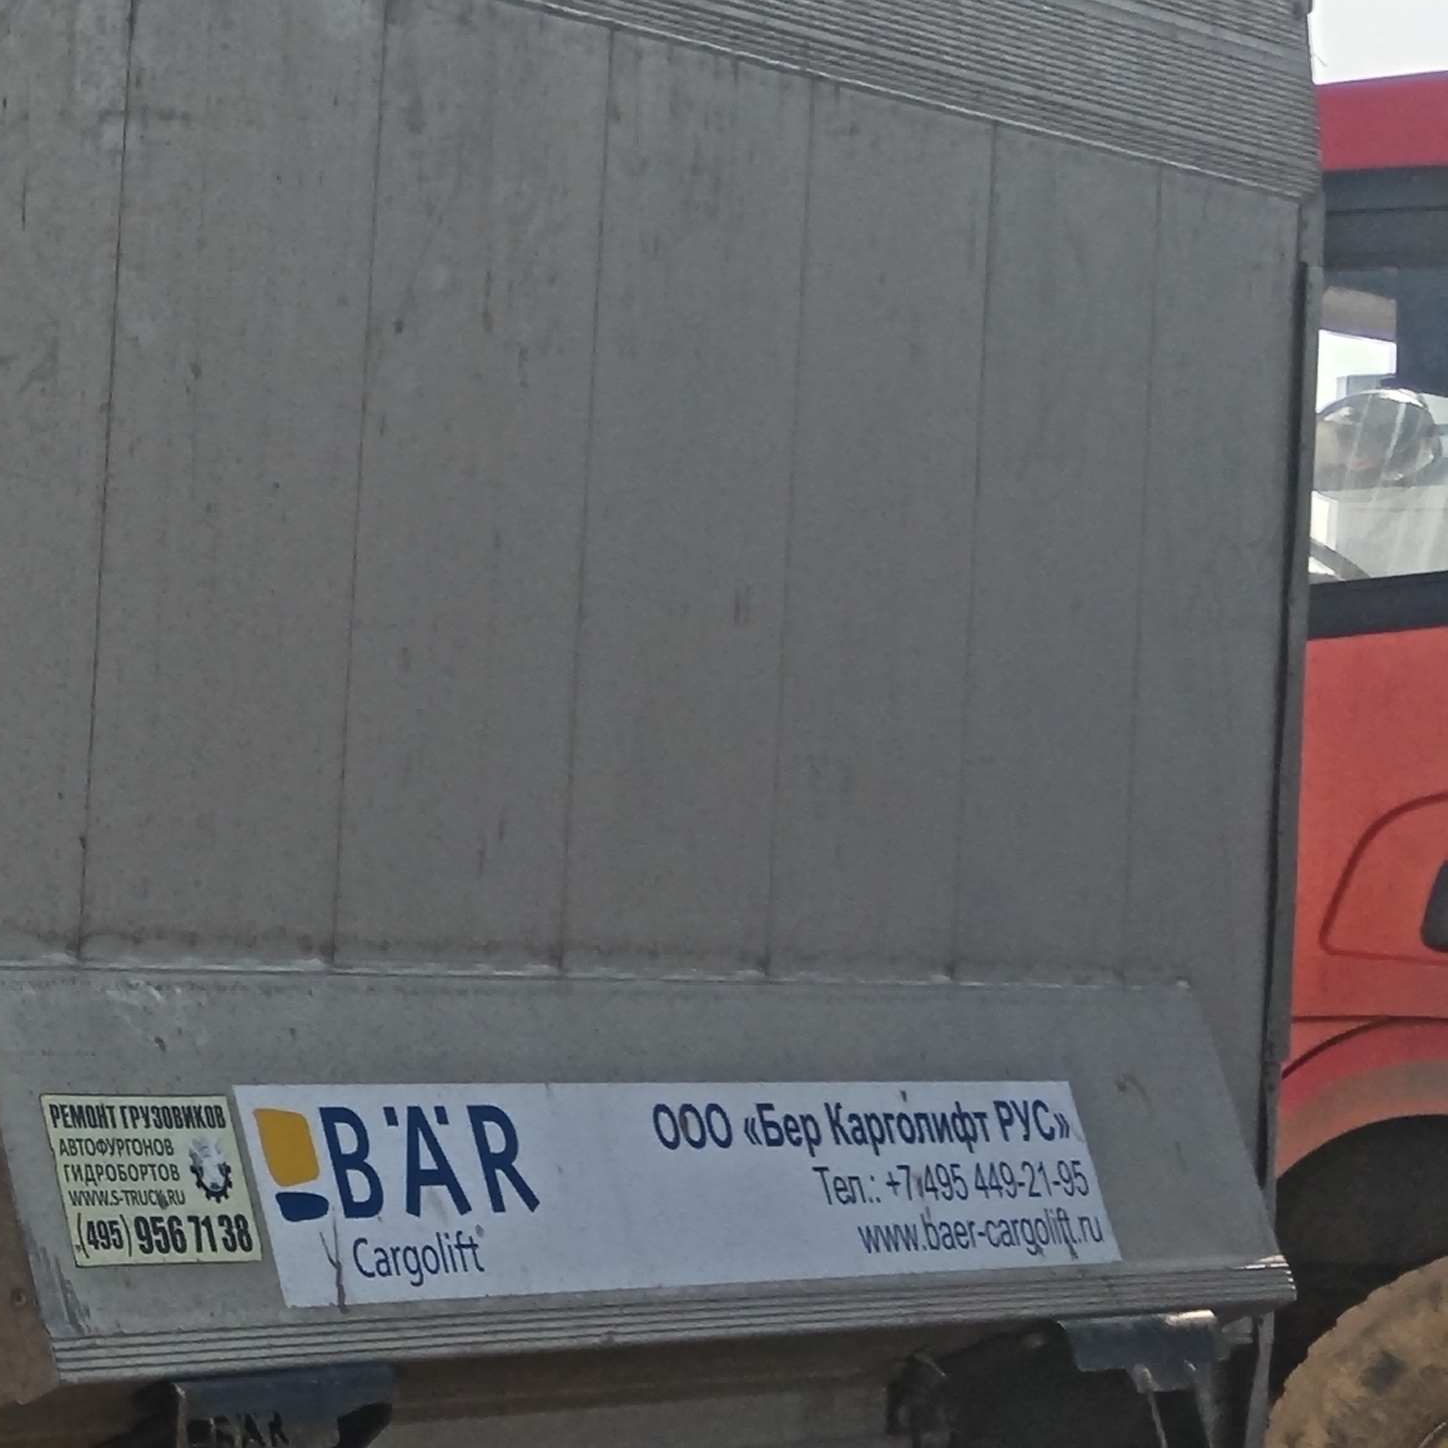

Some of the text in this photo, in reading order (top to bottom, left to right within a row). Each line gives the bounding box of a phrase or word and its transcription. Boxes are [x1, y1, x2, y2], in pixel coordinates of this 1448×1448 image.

[49, 1103, 226, 1130] РЕМОНТ ГРУЗОВИКОВ
[652, 1098, 1071, 1157] ООО «Бер Карголифт РУС»
[59, 1138, 175, 1158] АВТОФУРГОНОВ
[63, 1163, 181, 1187] ГИДРОБОРТОВ
[812, 1159, 1090, 1206] Тел.: +7 495 449-21-95
[134, 1215, 187, 1254] 956
[187, 1215, 218, 1254] 71
[218, 1214, 253, 1253] 38
[857, 1206, 1105, 1259] www.baer-cargolift.ru
[352, 1230, 485, 1288] Cargolift
